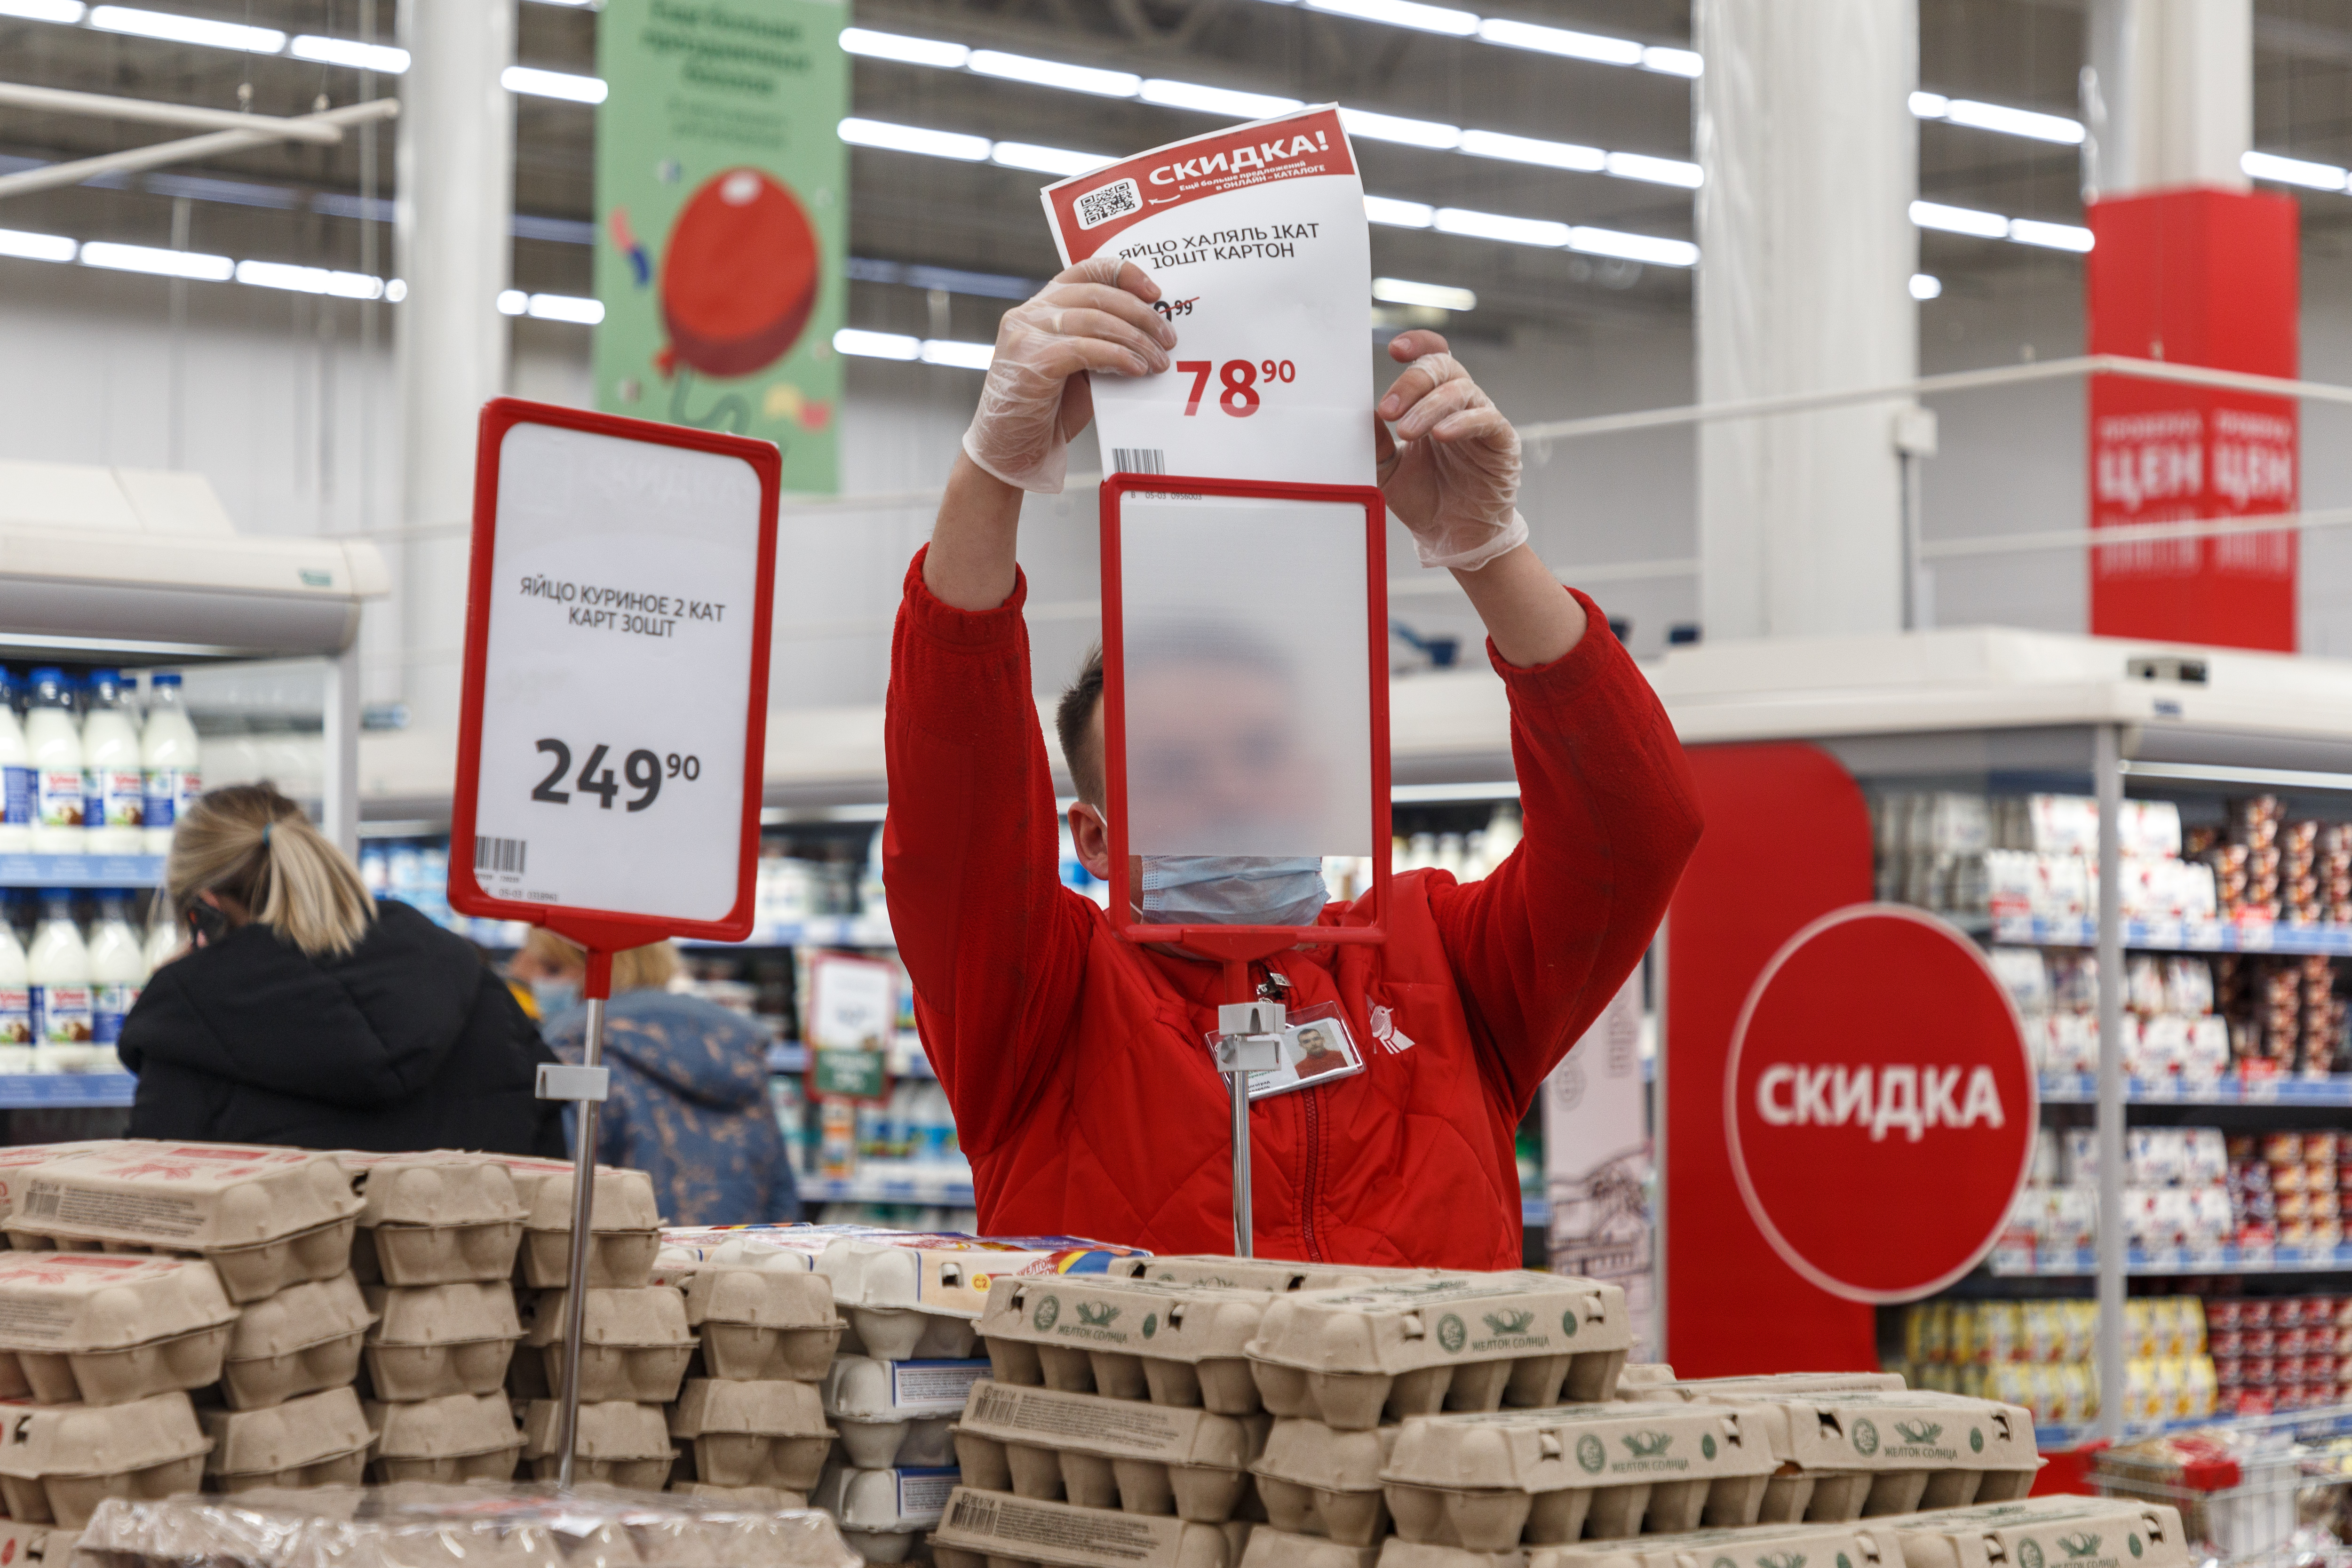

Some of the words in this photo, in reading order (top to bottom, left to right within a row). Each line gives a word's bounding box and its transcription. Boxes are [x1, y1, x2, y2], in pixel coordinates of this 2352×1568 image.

[1149, 130, 1329, 185] СКИДКА!
[1179, 182, 1200, 191] Ещё
[1200, 175, 1239, 186] больше
[1240, 160, 1306, 179] предложений
[1223, 176, 1267, 190] ОНЛАЙН
[1274, 165, 1326, 179] КАТАЛОГЕ
[1119, 239, 1177, 260] ЯЙЦО
[1182, 227, 1268, 249] ХАЛЯЛЬ
[1271, 223, 1319, 239] 1КАТ
[1152, 249, 1208, 269] 10ШТ
[1214, 242, 1295, 260] КАРТОН
[2098, 444, 2202, 510] ЦЕН
[2213, 444, 2291, 509] ЦЕН
[520, 574, 575, 604] ЯЙЦО
[580, 585, 669, 615] КУРИНОЕ
[674, 598, 683, 617] 2
[689, 601, 726, 622] КАТ
[569, 606, 617, 629] КАРТ
[621, 614, 676, 638] 30ШТ
[1756, 1063, 2005, 1142] СКИДКА
[1058, 1324, 1092, 1338] ЖЕЛТОК
[1093, 1330, 1128, 1345] СОЛНЦА
[1472, 1339, 1510, 1353] ЖЕЛТОК
[1513, 1336, 1550, 1349] СОЛНЦА
[1612, 1461, 1650, 1474] ЖЕЛТОК
[1653, 1459, 1690, 1472] СОЛНЦА
[1884, 1447, 1921, 1458] ЖЕЛТОК
[1923, 1448, 1958, 1461] СОЛНЦА
